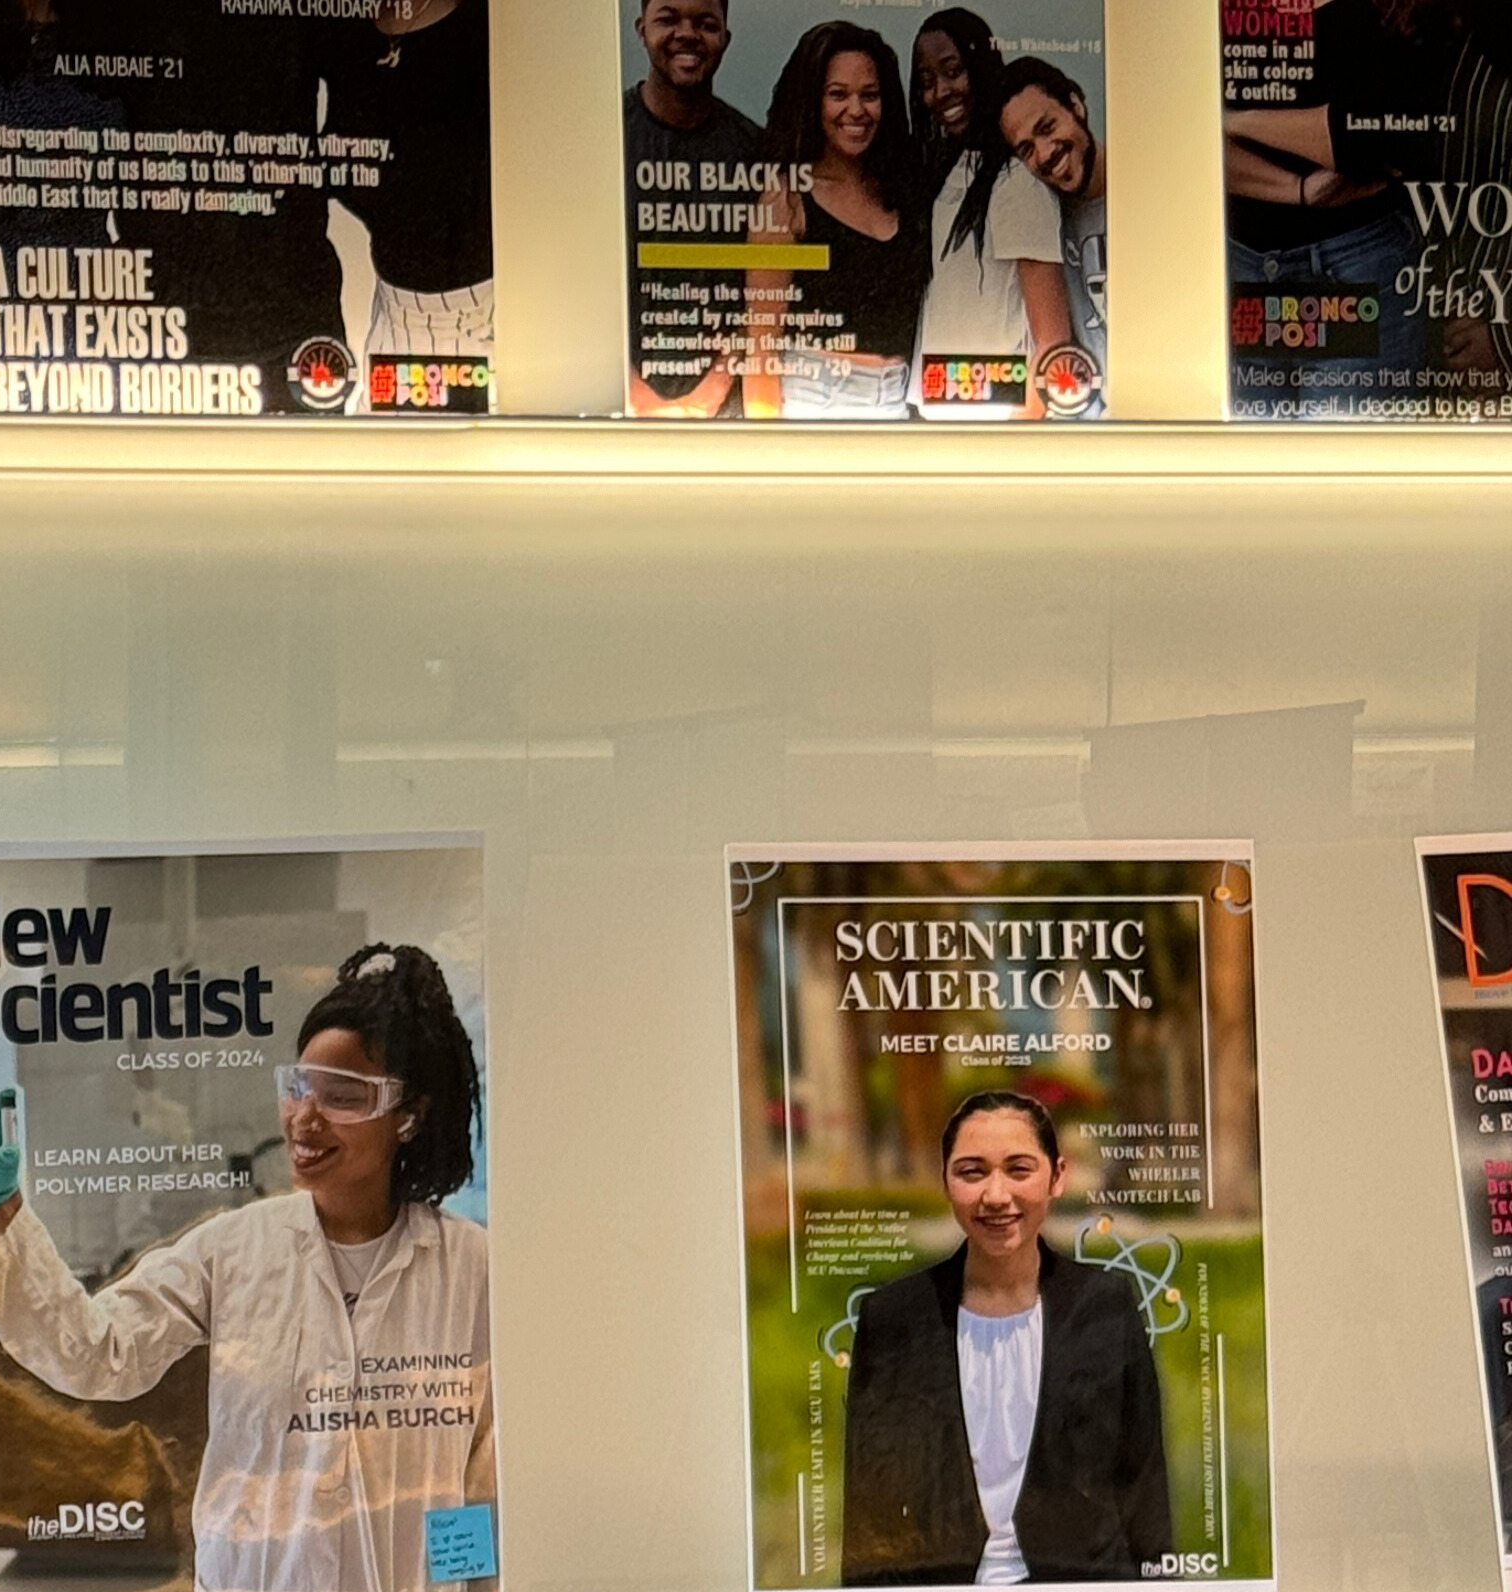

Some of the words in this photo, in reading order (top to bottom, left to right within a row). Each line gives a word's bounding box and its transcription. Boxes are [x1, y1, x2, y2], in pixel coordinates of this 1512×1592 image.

[1223, 12, 1313, 37] WOMEN
[1224, 44, 1267, 59] come
[1273, 42, 1288, 58] in
[1294, 41, 1314, 59] all
[54, 55, 89, 75] ALIA
[95, 56, 154, 77] RUBAIE
[1224, 61, 1258, 80] skin
[1264, 62, 1313, 80] colors
[1225, 83, 1236, 100] &
[1242, 82, 1296, 101] outfits
[1347, 114, 1380, 131] Lana
[102, 128, 130, 150] the
[234, 131, 313, 159] diversity,
[317, 134, 394, 162] vibrancy,
[16, 155, 92, 182] humanity
[97, 157, 115, 180] of
[119, 161, 138, 180] us
[143, 158, 186, 181] leads
[192, 162, 208, 182] to
[214, 160, 245, 182] this
[330, 164, 348, 186] of
[352, 164, 379, 187] the
[637, 162, 690, 191] OUR
[701, 163, 782, 192] BLACK
[791, 164, 814, 192] IS
[41, 184, 79, 208] East
[83, 185, 119, 209] that
[123, 187, 138, 209] is
[142, 188, 190, 214] really
[638, 202, 788, 232] BEAUTIFUL.
[17, 248, 154, 300] CULTURE
[76, 306, 187, 358] EXISTS
[1265, 323, 1326, 348] POSI
[120, 364, 262, 415] BORDERS
[836, 920, 1145, 962] SCIENTIFIC
[881, 1036, 938, 1053] MEET
[943, 1036, 1020, 1051] CLAIRE
[1025, 1035, 1110, 1051] ALFORD
[117, 1053, 179, 1071] CLASS
[185, 1051, 212, 1070] OF
[217, 1050, 263, 1069] 2024
[962, 1055, 989, 1066] Class
[991, 1055, 1003, 1065] of
[1080, 1124, 1164, 1138] EXPLORING
[1169, 1123, 1199, 1136] HER
[34, 1148, 100, 1167] LEARN
[106, 1147, 177, 1164] ABOUT
[182, 1144, 224, 1163] HER
[1101, 1146, 1144, 1160] WORK
[1149, 1146, 1164, 1159] IN
[1169, 1145, 1200, 1158] THE
[35, 1176, 131, 1195] POLYMER
[137, 1172, 249, 1192] RESEARCH!
[1128, 1168, 1200, 1181] WHEELER
[1087, 1190, 1168, 1204] NANOTECH
[1173, 1189, 1200, 1203] LAB
[361, 1354, 473, 1373] EXAMINING
[306, 1383, 418, 1402] CHEMISTRY
[422, 1382, 473, 1398] WITH
[288, 1411, 378, 1433] ALISHA
[388, 1407, 475, 1429] BURCH
